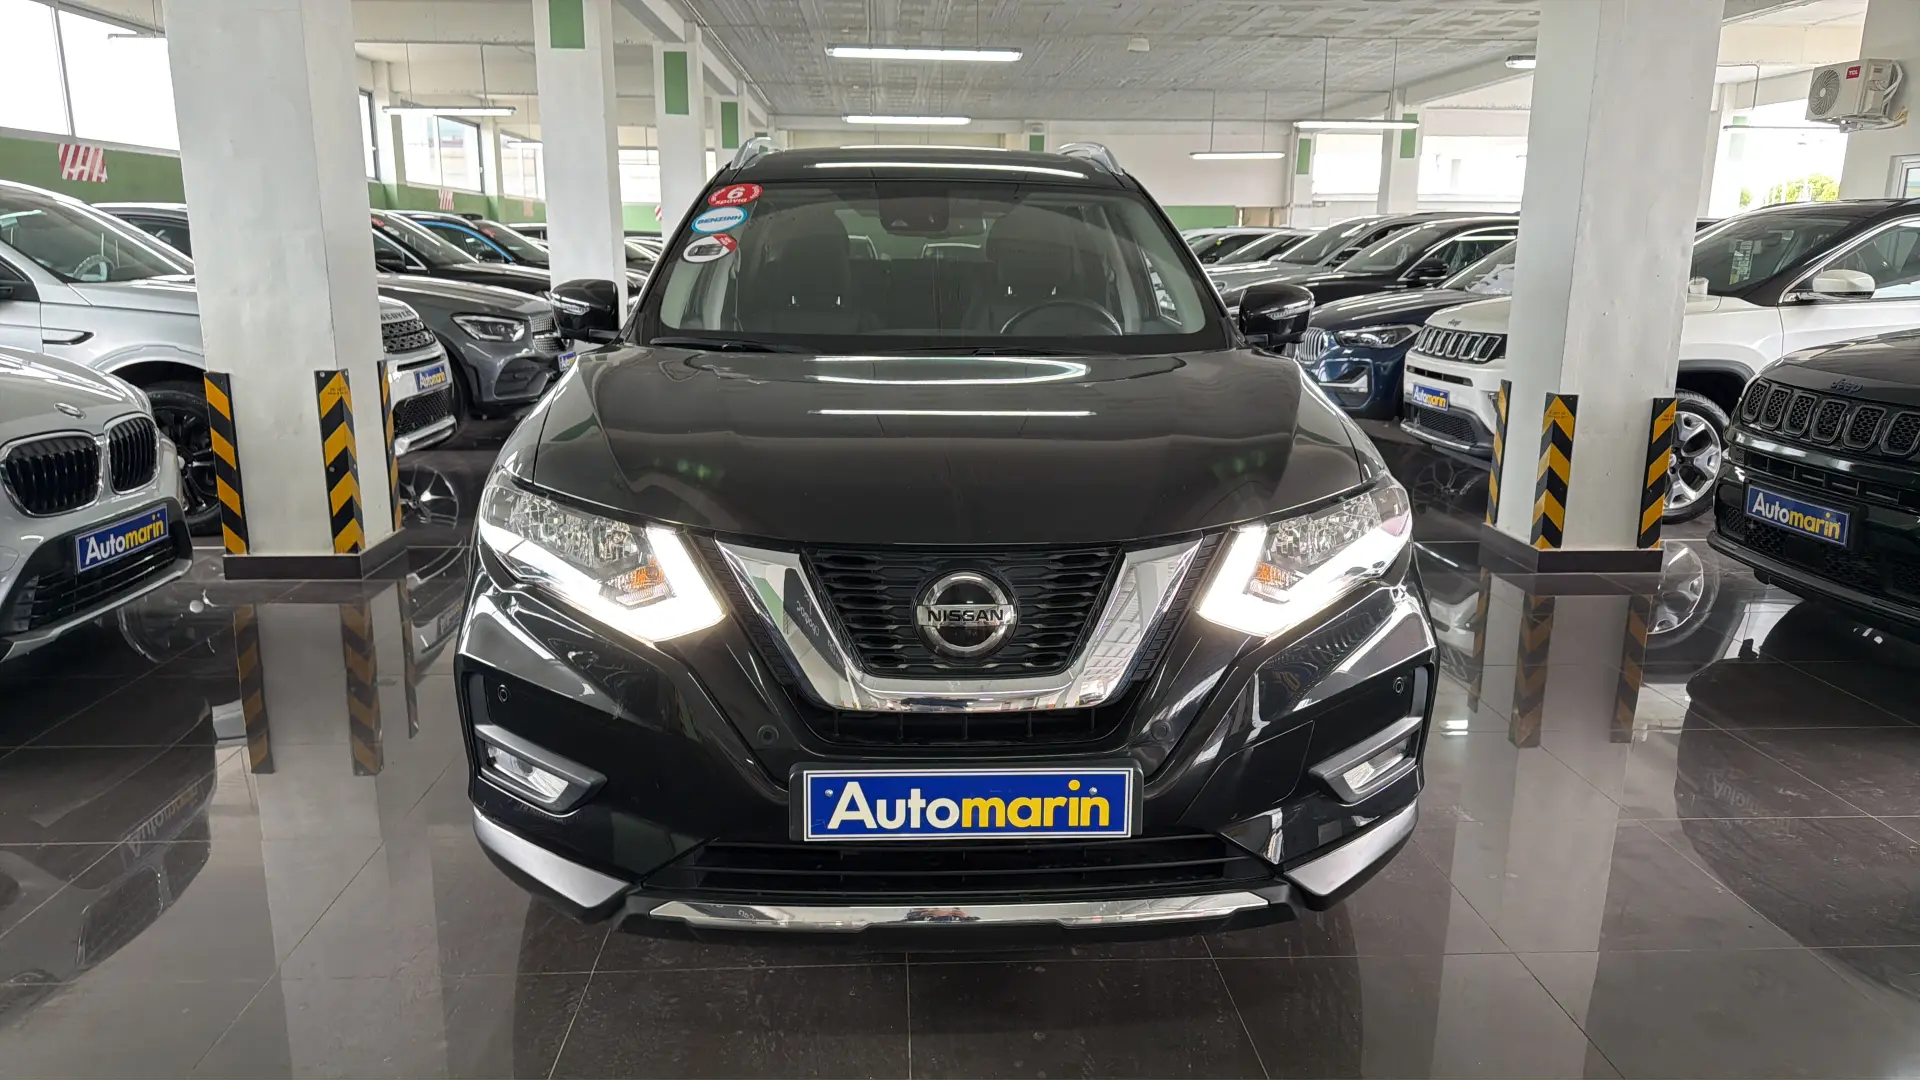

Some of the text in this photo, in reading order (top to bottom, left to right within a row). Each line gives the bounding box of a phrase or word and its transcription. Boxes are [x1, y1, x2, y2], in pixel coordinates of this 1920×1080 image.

[727, 187, 746, 200] 6
[1413, 385, 1446, 408] Automarin
[1830, 378, 1864, 394] Jeep
[1752, 492, 1841, 540] Automarin
[85, 514, 165, 566] Automarin
[927, 609, 1004, 622] NISSAN
[827, 779, 1110, 830] Automarin
